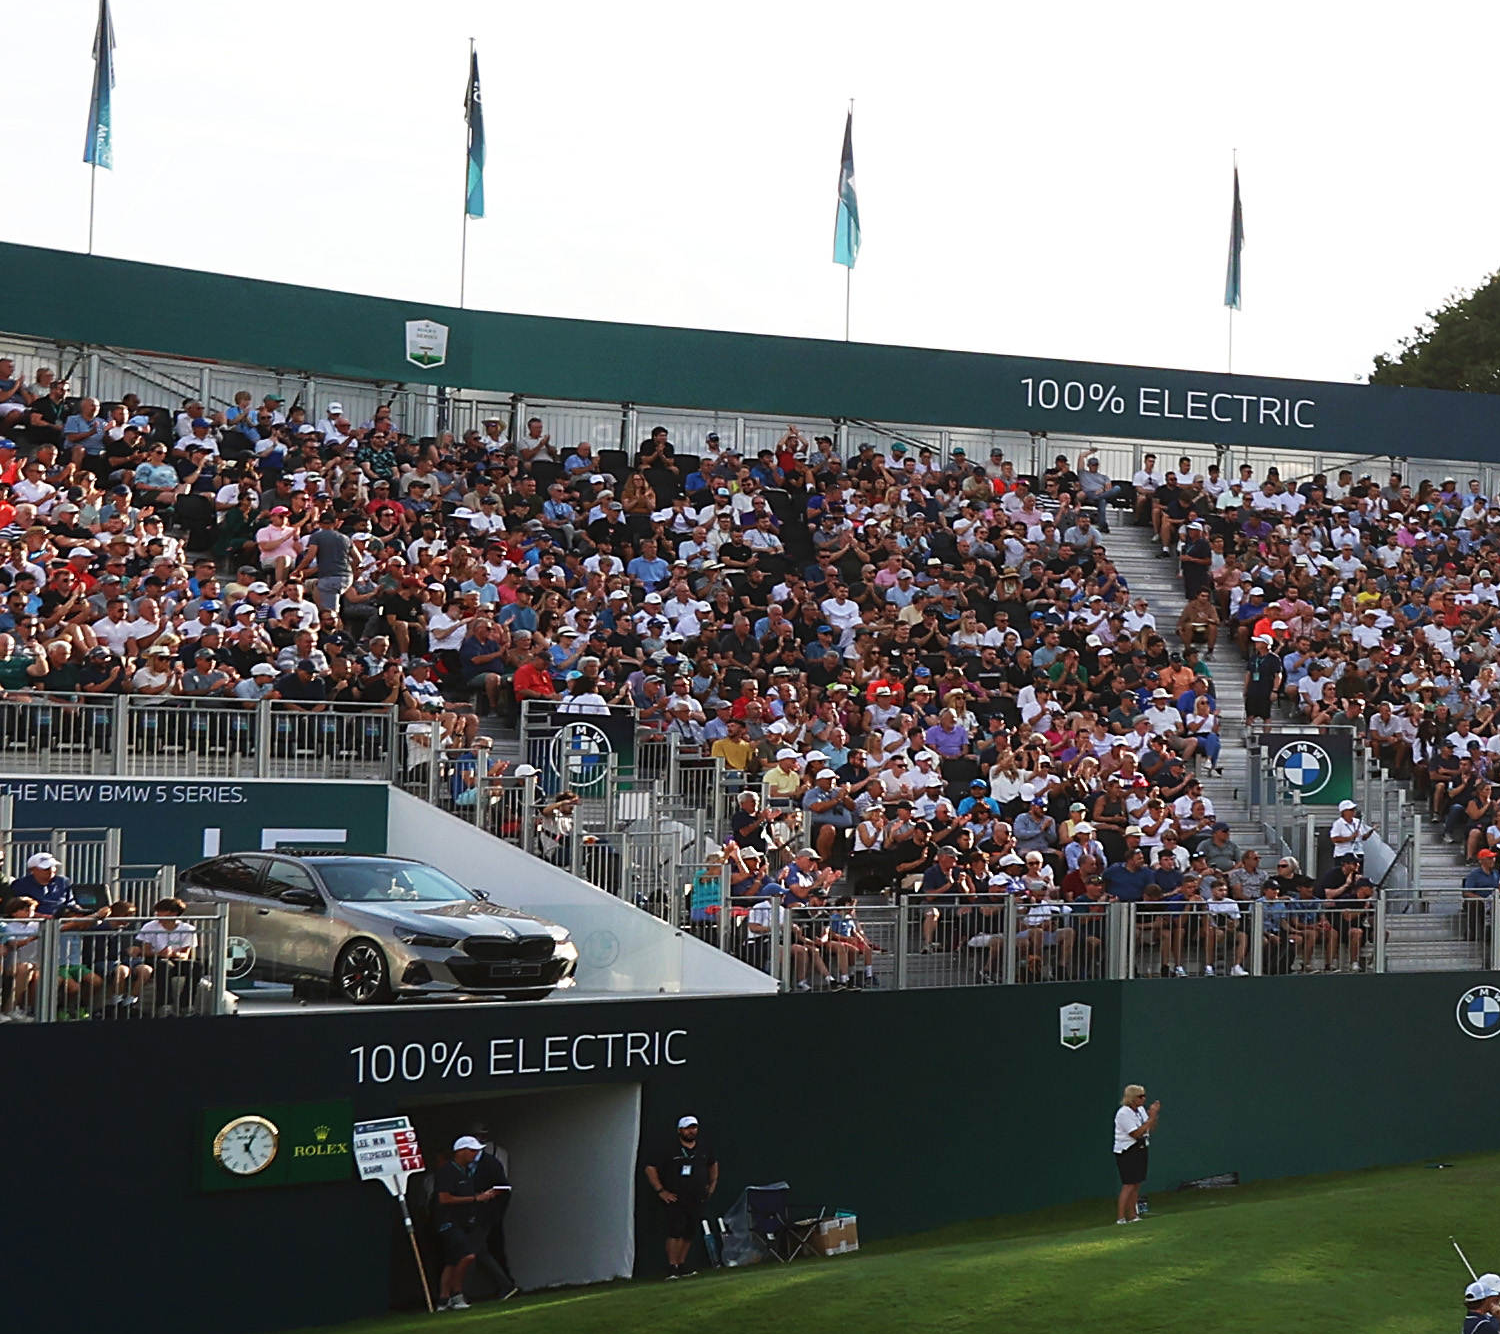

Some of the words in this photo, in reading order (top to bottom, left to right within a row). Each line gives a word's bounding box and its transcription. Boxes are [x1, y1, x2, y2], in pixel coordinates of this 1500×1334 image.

[1021, 378, 1125, 414] 100%
[1139, 387, 1315, 428] ELECTRIC
[1281, 744, 1324, 760] BMW
[0, 783, 38, 801] THE
[43, 784, 93, 802] NEW
[99, 785, 150, 802] BMW
[156, 786, 167, 802] 5
[172, 786, 248, 804] SERIES.
[350, 1041, 473, 1083] 100%
[489, 1030, 687, 1075] ELECTRIC
[396, 1131, 416, 1143] -9
[294, 1143, 348, 1157] ROLEX
[400, 1144, 418, 1157] -7
